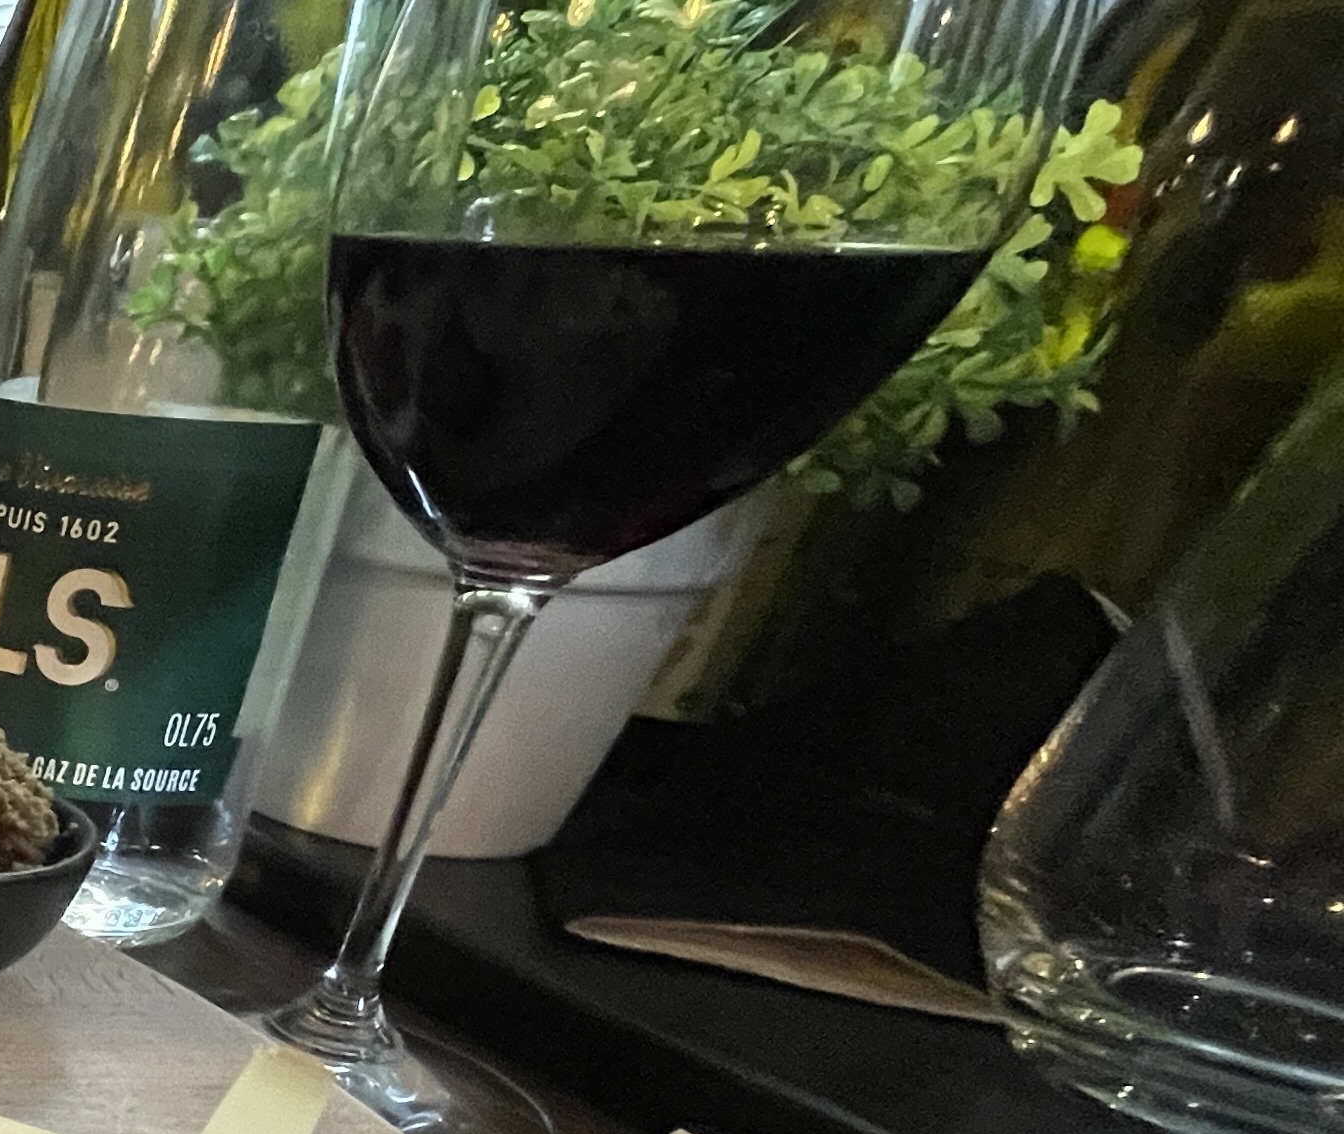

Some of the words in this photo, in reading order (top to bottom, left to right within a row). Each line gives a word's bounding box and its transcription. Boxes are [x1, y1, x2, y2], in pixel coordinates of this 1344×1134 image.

[59, 515, 120, 544] 1602
[31, 755, 70, 785] GAZ
[72, 762, 100, 787] DE
[101, 766, 126, 790] LA
[130, 767, 201, 793] SOURCE
